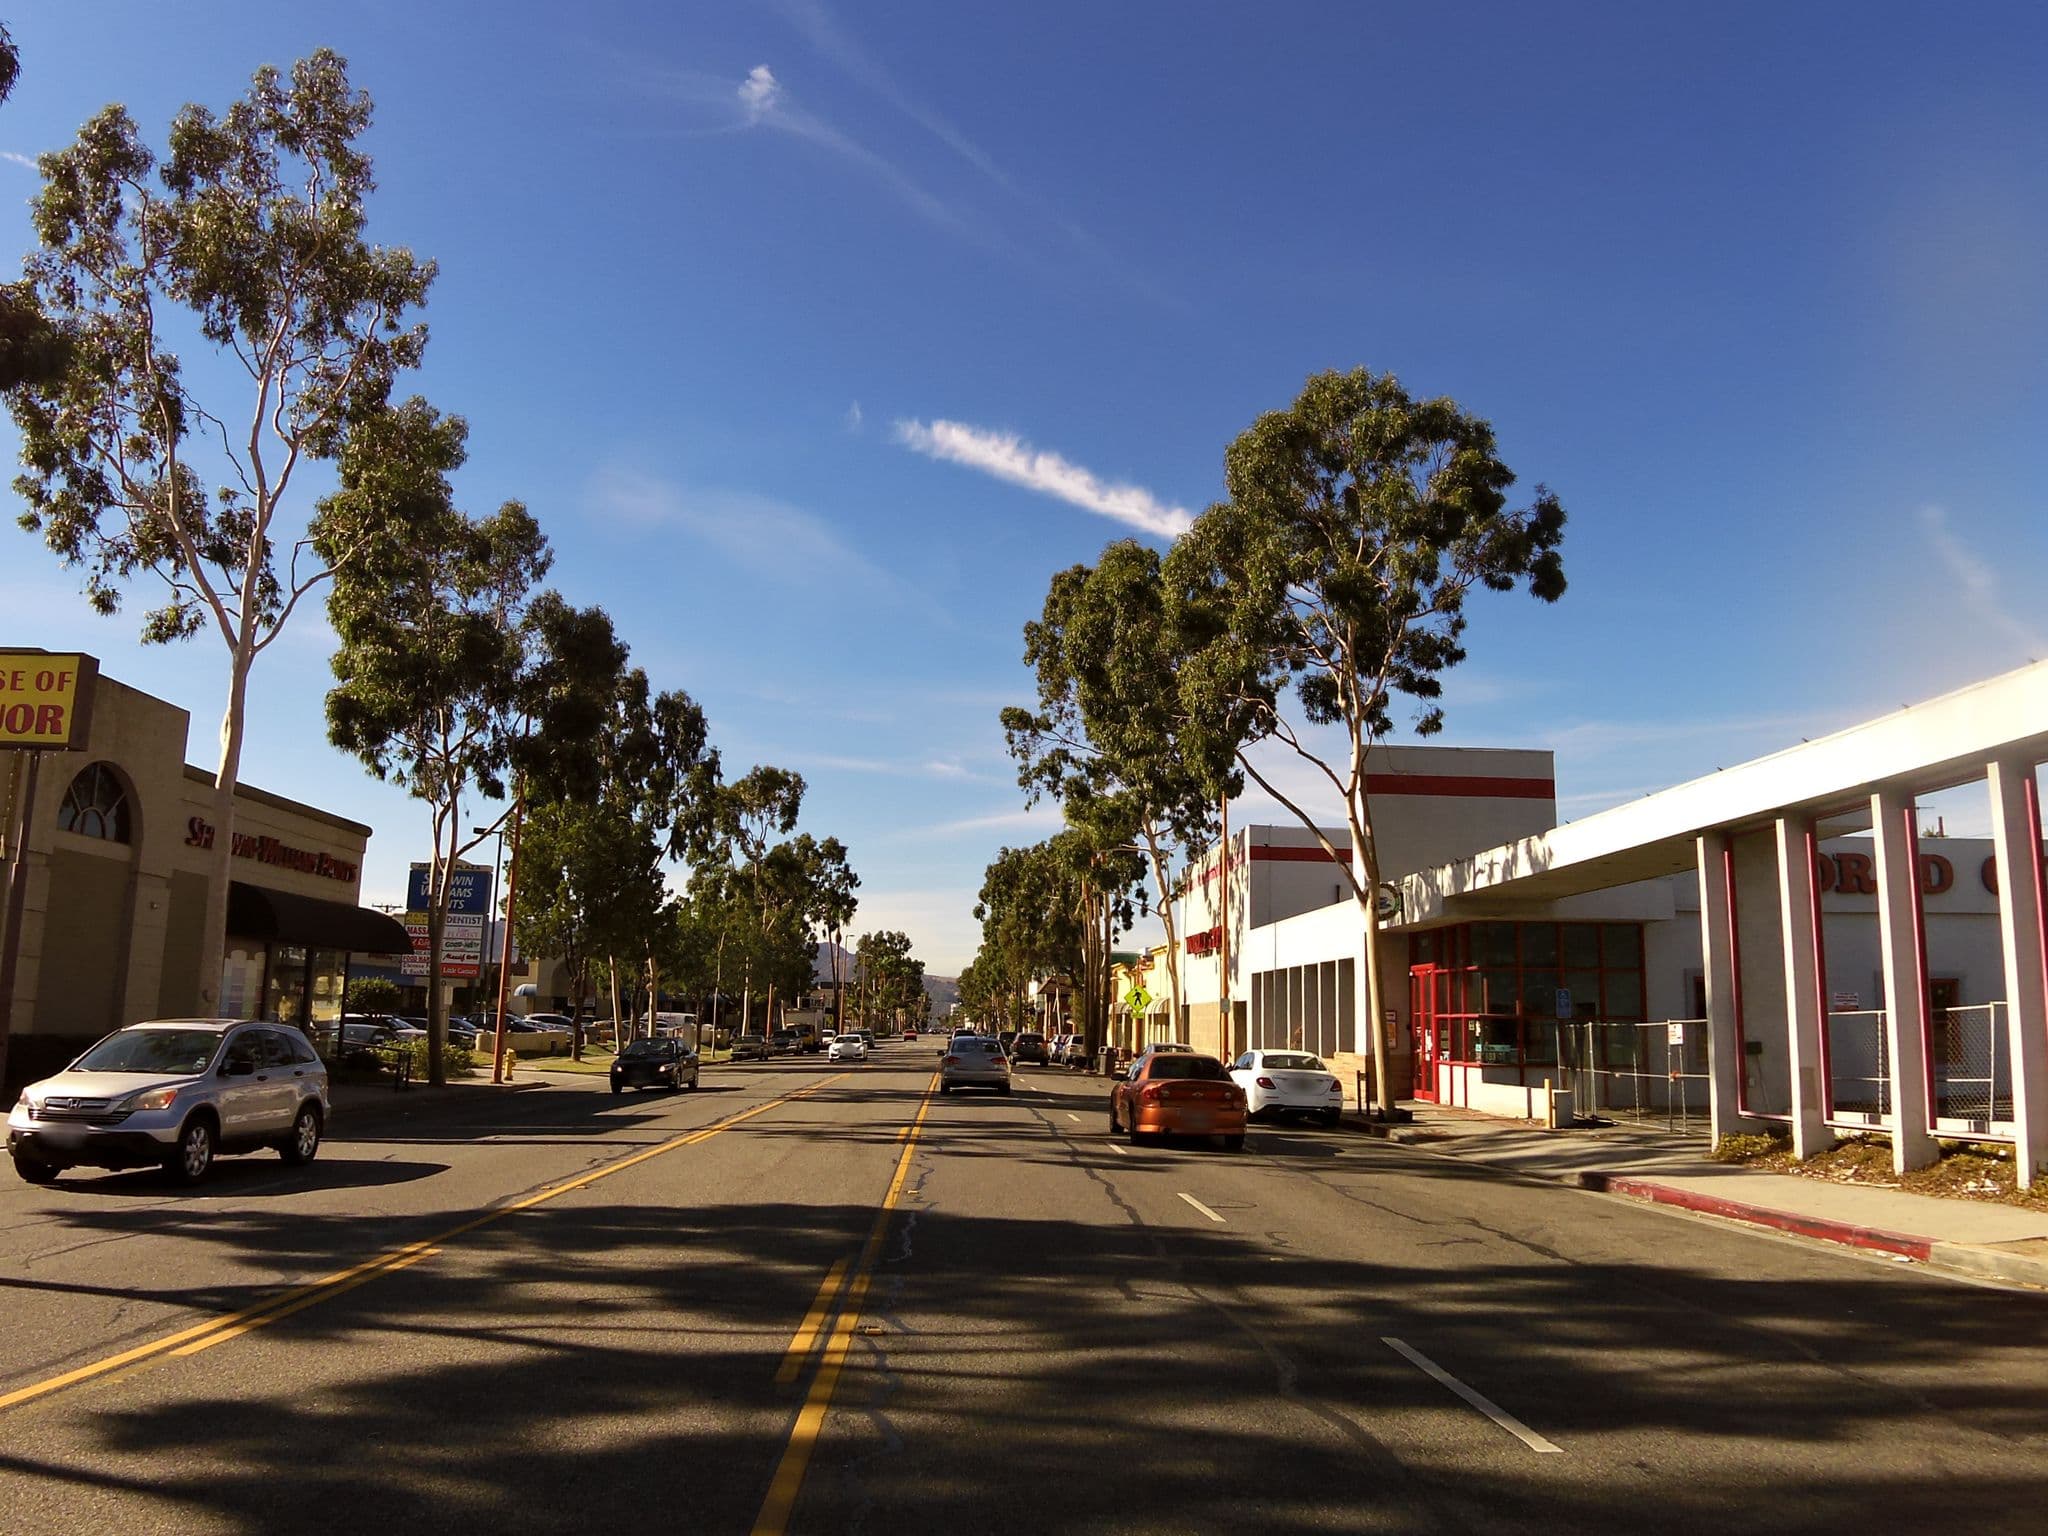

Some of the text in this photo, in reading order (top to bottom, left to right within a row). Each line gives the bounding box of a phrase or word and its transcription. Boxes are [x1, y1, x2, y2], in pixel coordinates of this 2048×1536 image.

[35, 670, 73, 692] OF
[0, 703, 65, 735] OR
[447, 916, 481, 924] DENTIST
